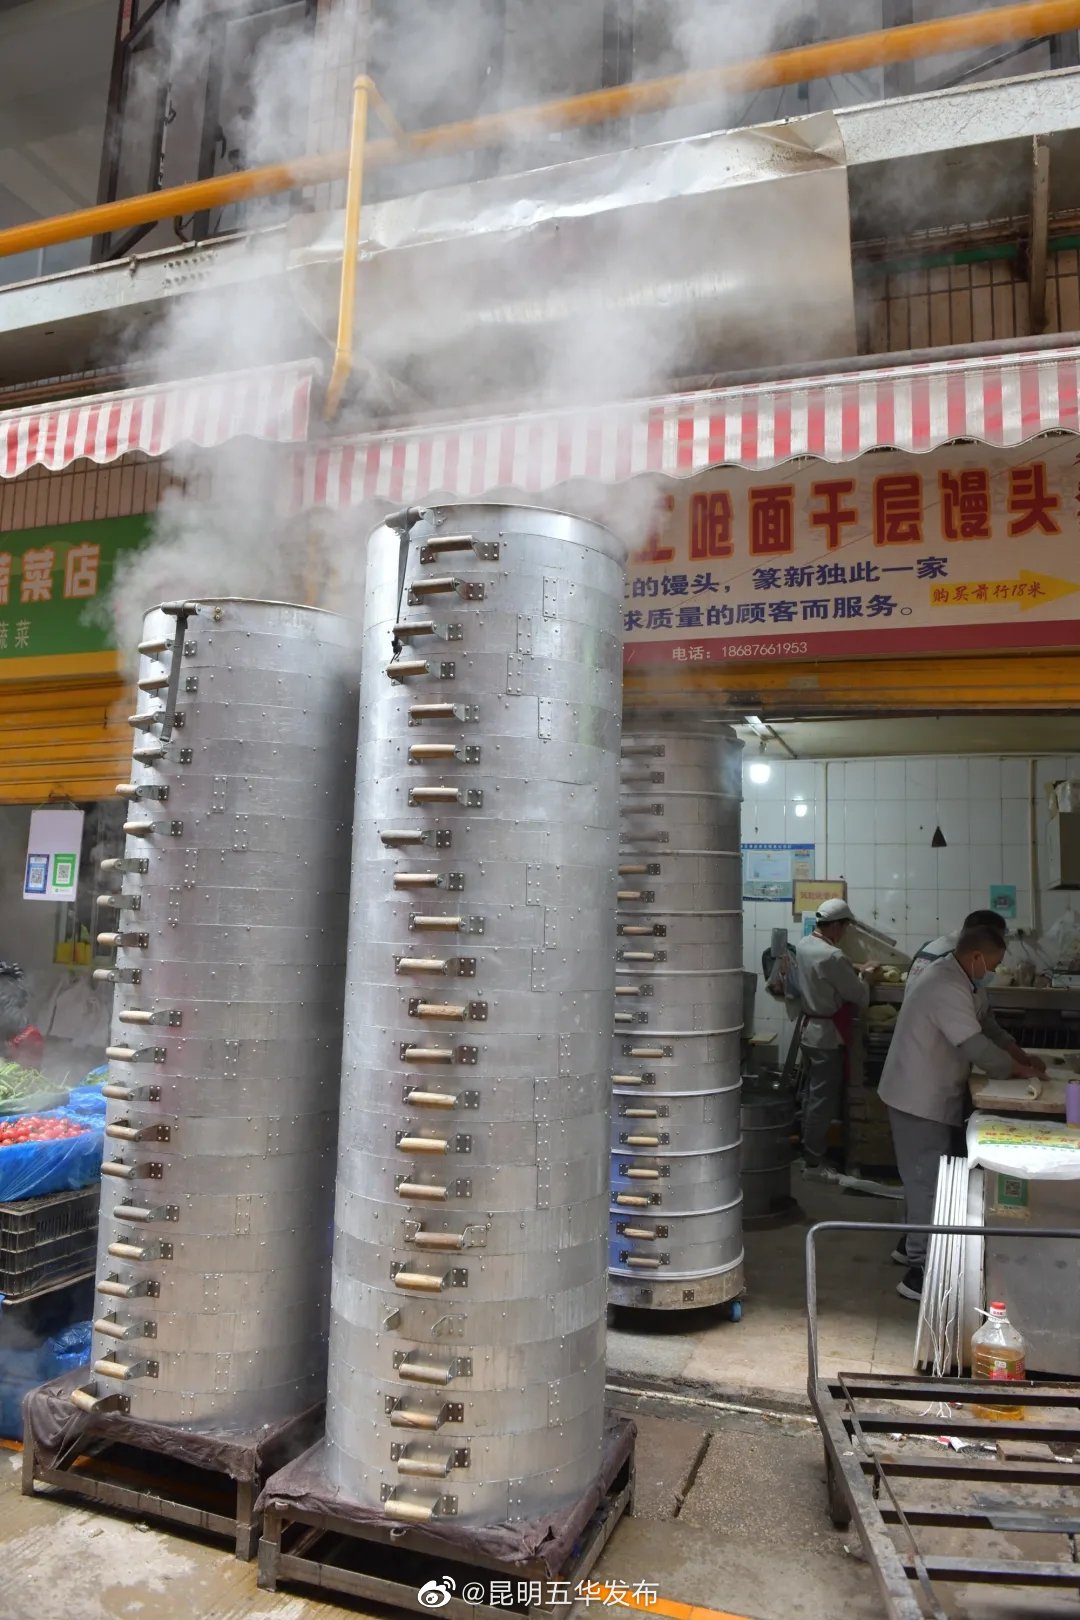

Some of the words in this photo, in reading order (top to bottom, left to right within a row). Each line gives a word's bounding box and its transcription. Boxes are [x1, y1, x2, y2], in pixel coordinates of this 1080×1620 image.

[624, 556, 948, 599] 的馒头，篆新独此一家
[933, 581, 1046, 603] 购买前行18米
